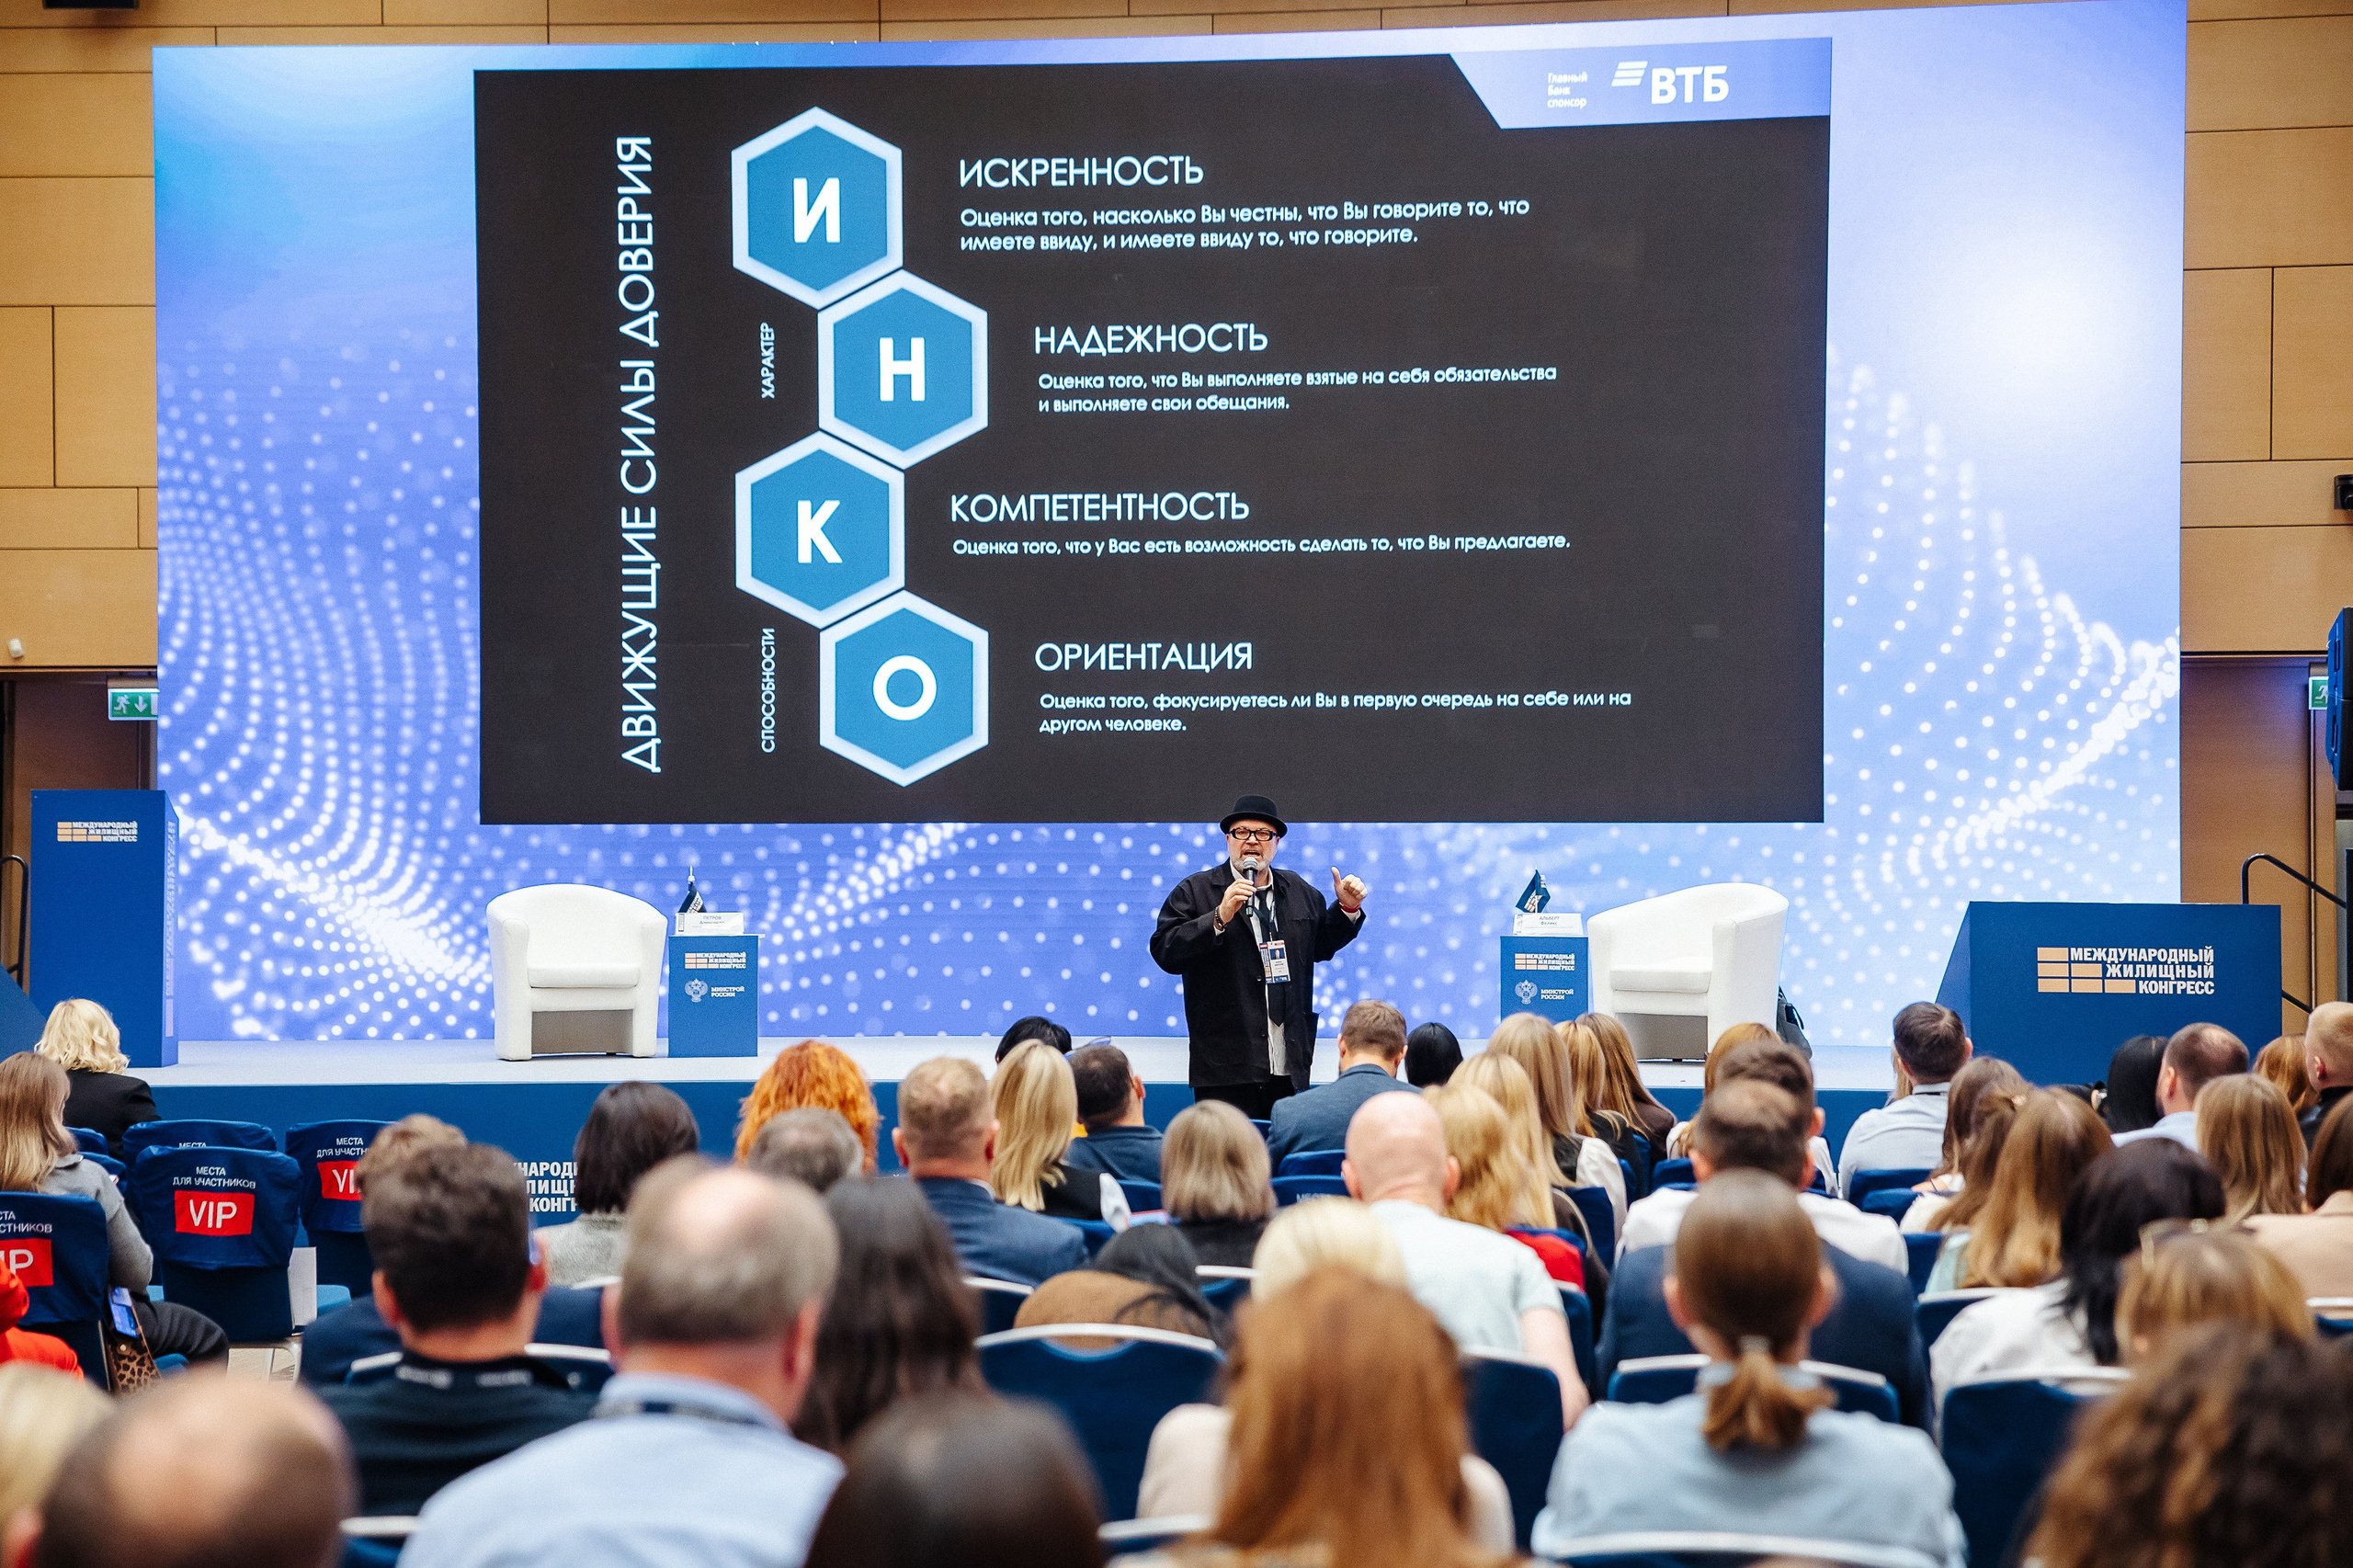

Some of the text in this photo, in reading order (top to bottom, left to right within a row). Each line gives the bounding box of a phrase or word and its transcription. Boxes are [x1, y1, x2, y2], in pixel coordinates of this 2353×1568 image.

[1548, 71, 1588, 83] Главный
[1651, 65, 1729, 104] ВТБ
[1547, 97, 1587, 109] спонсор
[960, 155, 1204, 188] ИСКРЕННОСТЬ
[793, 177, 840, 243] И
[961, 200, 1529, 228] Оценка того, насколько Вы честны, что Вы говорите то, что
[961, 228, 1418, 254] имеете ввиду, и имеете ввиду то, что говорите.
[1034, 324, 1268, 357] НАДЕЖНОСТЬ
[759, 322, 775, 399] ХАРАКТЕР
[879, 337, 926, 402] Н
[1039, 367, 1556, 390] Оценка того, что Вы выполняете взятые на себя обязательства
[1039, 395, 1290, 414] и выполняете свои обещания.
[616, 137, 662, 773] ДВИЖУЩИЕ СИЛЫ ДОВЕРИЯ
[950, 492, 1250, 522] КОМПЕТЕНТНОСТЬ
[797, 500, 843, 563] К
[953, 535, 1571, 558] Оценка того, что у Вас есть возможность сделать то, что Вы предлагаете.
[1034, 642, 1253, 674] ОРИЕНТАЦИЯ
[761, 628, 776, 753] СПОСОБНОСТИ
[872, 655, 937, 721] О
[1040, 690, 1631, 712] Оценка того, фокусируетесь ли Вы в первую очередь на себе или на
[1040, 719, 1188, 735] другом человеке.
[72, 821, 138, 829] МЕЖДУНАРОДНЫЙ
[2070, 946, 2214, 965] МЕЖДУНАРОДНЫЙ
[2106, 963, 2214, 981] ЖИЛИЩНЫЙ
[2138, 980, 2215, 995] КОНГРЕСС
[316, 1148, 368, 1158] ДЛЯ УЧАСТН
[336, 1137, 364, 1145] МЕСТА
[172, 1176, 256, 1189] ДЛЯ УЧАСТНИКОВ
[196, 1166, 226, 1176] МЕСТА
[332, 1168, 356, 1195] VI
[189, 1199, 237, 1229] VIP
[0, 1222, 52, 1233] СТНИКОВ
